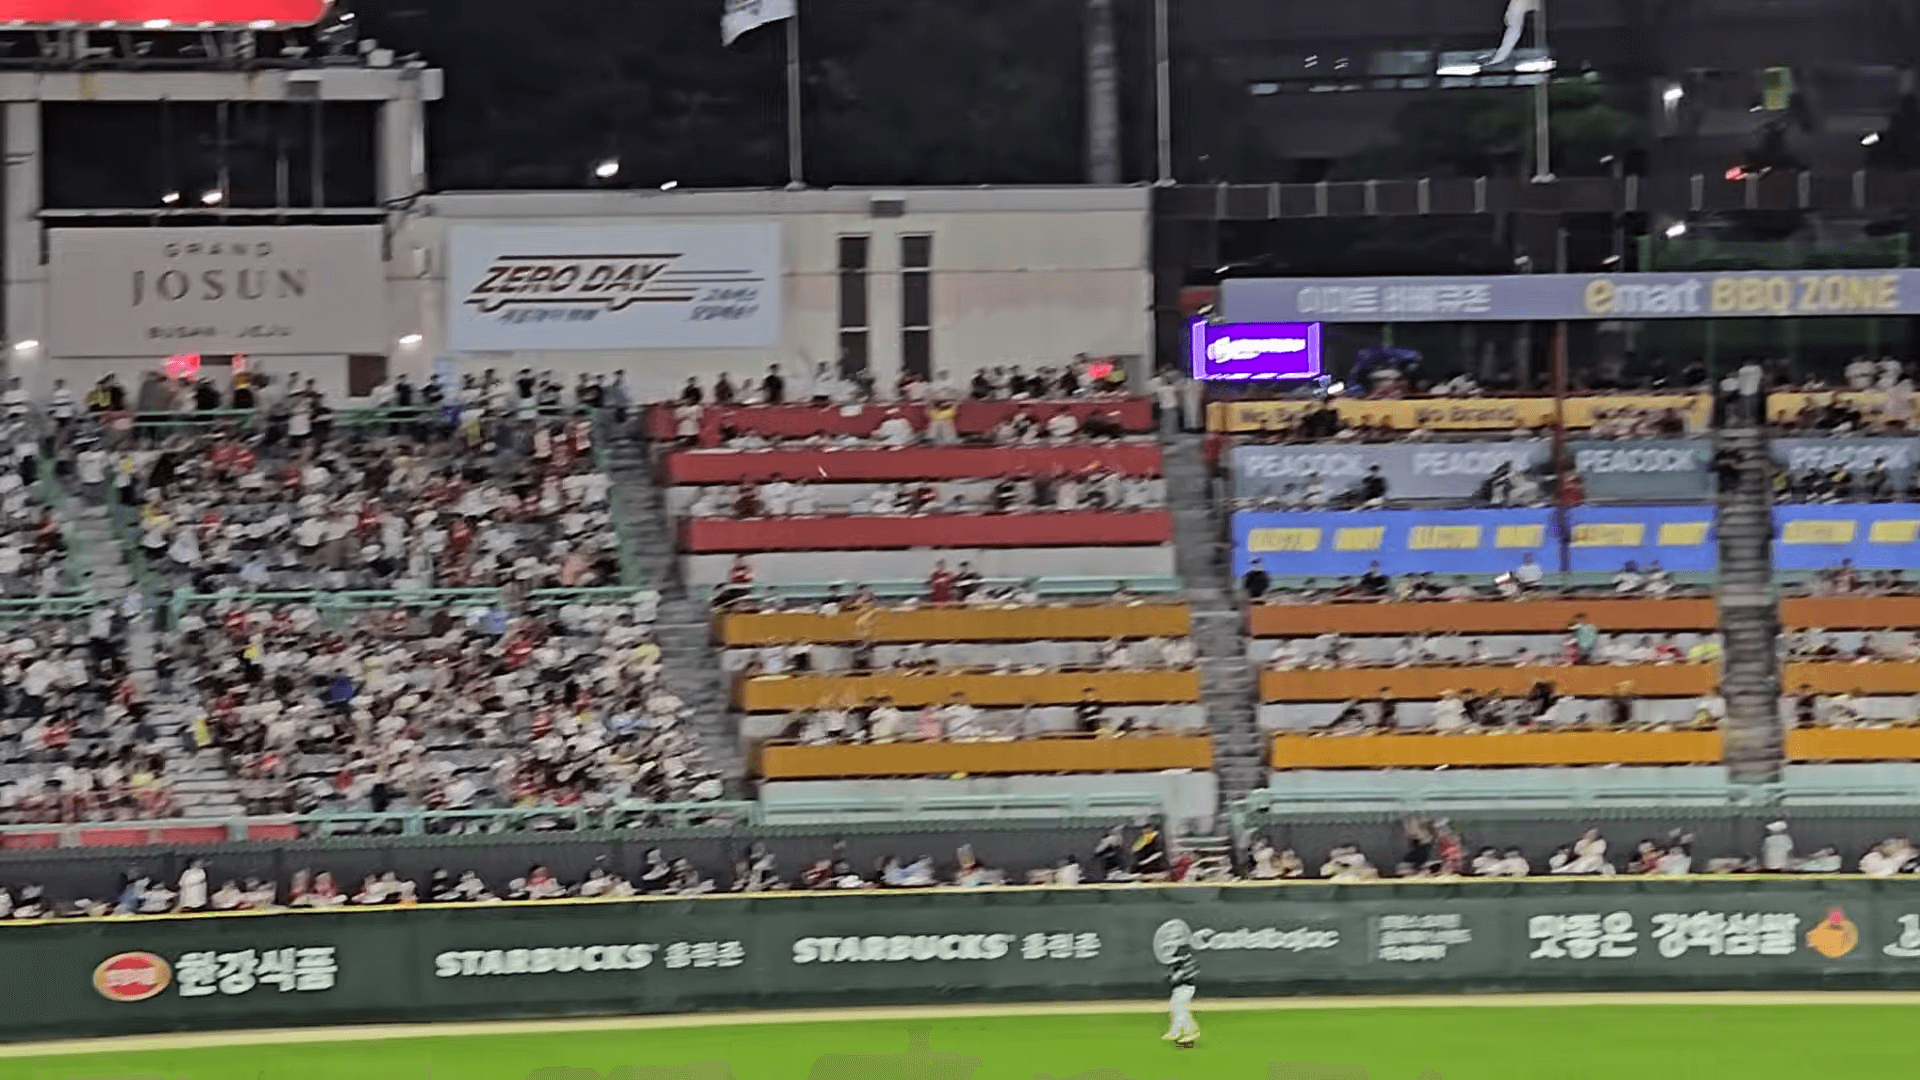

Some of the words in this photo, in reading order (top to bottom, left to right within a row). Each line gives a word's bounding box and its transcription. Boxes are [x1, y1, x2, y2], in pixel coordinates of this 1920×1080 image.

[165, 242, 272, 258] GRAND
[132, 269, 307, 307] JOSUN
[471, 265, 580, 294] ZERO
[577, 264, 667, 293] DAY
[1585, 279, 1701, 313] emart
[1712, 277, 1793, 312] BBQ
[1798, 275, 1898, 309] ZONE
[1576, 449, 1695, 473] PEACOCK
[793, 933, 1009, 963] STARBUCKS
[1528, 911, 1639, 959] 맛좋은
[1651, 910, 1800, 958] 강화섬쌀
[175, 946, 338, 997] 한강식품
[435, 944, 654, 977] STARBUCKS
